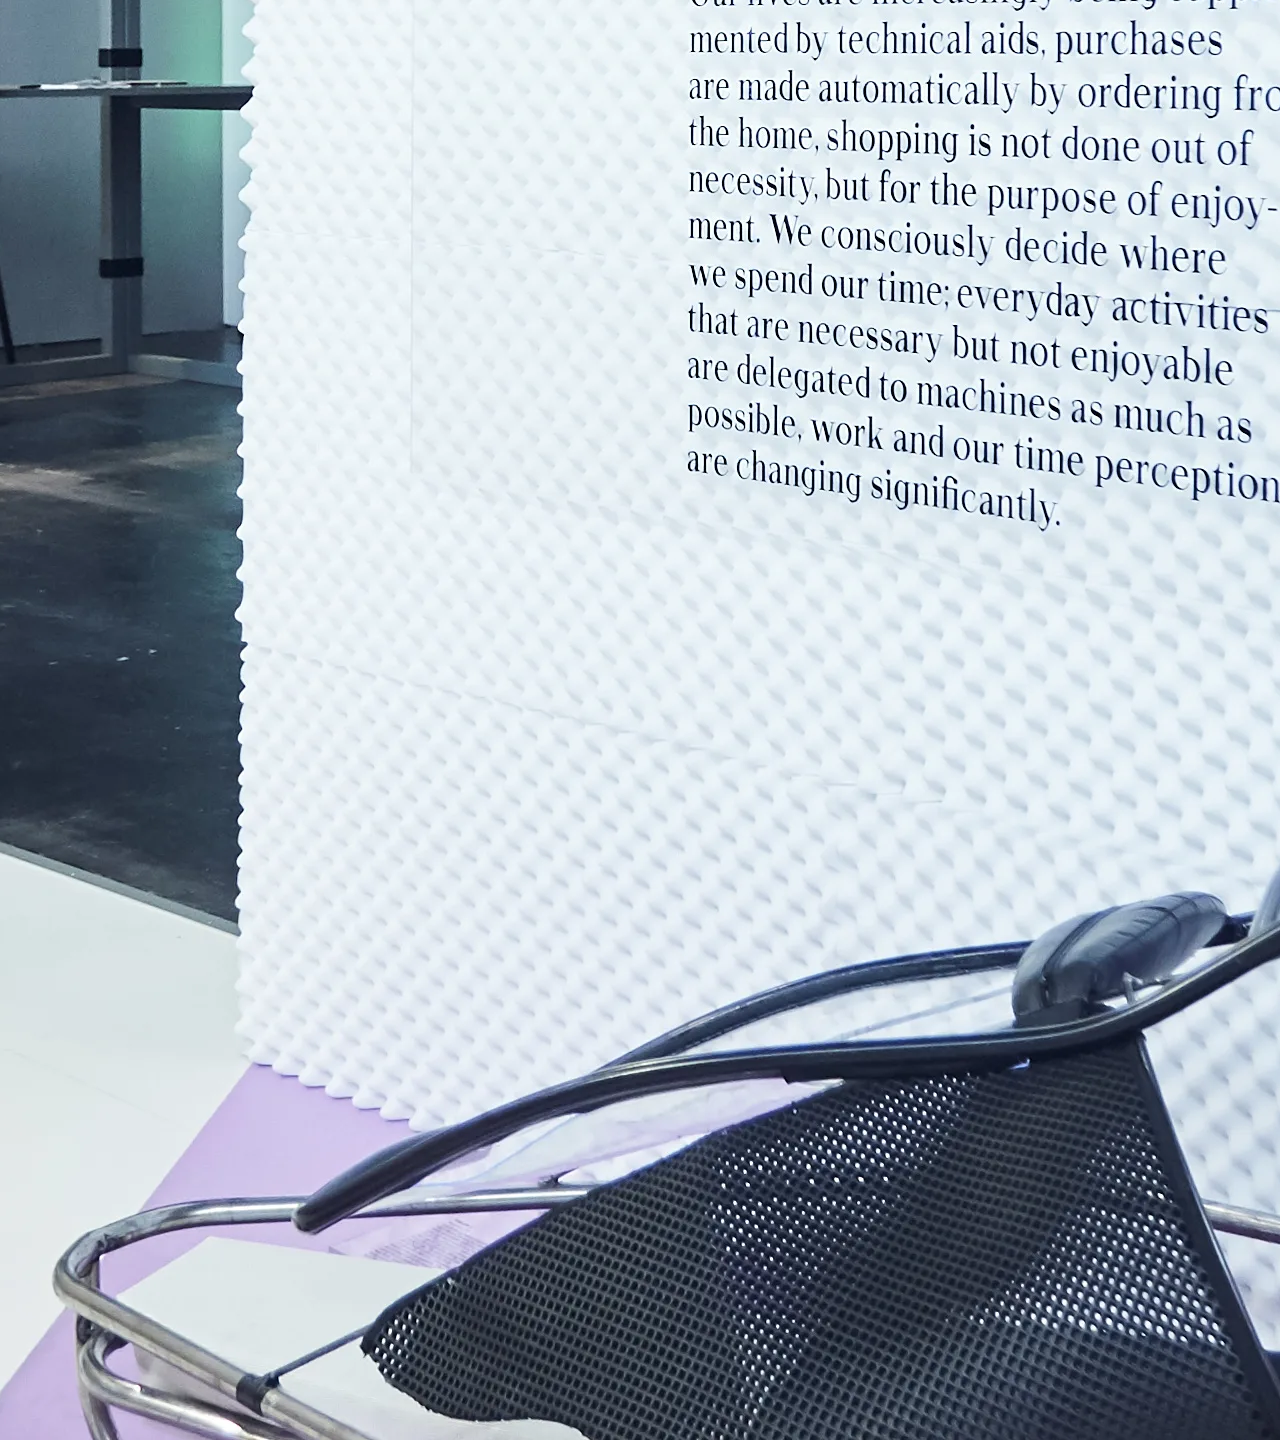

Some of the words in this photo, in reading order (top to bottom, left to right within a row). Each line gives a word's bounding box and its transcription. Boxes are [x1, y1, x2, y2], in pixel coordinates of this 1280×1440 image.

[689, 21, 789, 54] mented
[795, 21, 829, 62] by
[836, 20, 972, 55] technical
[980, 20, 1046, 58] aids,
[1055, 19, 1223, 64] purchases
[688, 78, 730, 101] are
[738, 69, 811, 103] made
[818, 71, 1021, 115] automatically
[1029, 71, 1068, 116] by
[1077, 72, 1223, 120] ordering
[688, 115, 730, 148] the
[737, 116, 819, 155] home,
[826, 118, 960, 164] shopping
[968, 123, 992, 157] is
[1001, 128, 1052, 159] not
[1061, 125, 1141, 163] done
[1150, 132, 1208, 165] out
[1216, 128, 1255, 167] of
[688, 166, 819, 206] necessity,
[825, 166, 871, 202] but
[878, 168, 921, 204] for
[929, 171, 978, 208] the
[986, 184, 1118, 220] purpose
[1127, 180, 1164, 217] of
[1171, 184, 1278, 231] enjoy-
[688, 215, 761, 244] ment.
[768, 213, 813, 247] We
[820, 221, 996, 267] consciously
[1005, 226, 1109, 267] decide
[1118, 234, 1227, 276] where
[688, 263, 728, 289] we
[734, 262, 813, 299] spend
[821, 274, 870, 300] our
[876, 270, 950, 311] time;
[956, 281, 1102, 328] everyday
[1111, 290, 1270, 336] activities
[687, 301, 740, 337] that
[746, 315, 790, 342] are
[797, 321, 944, 364] necessary
[951, 324, 1001, 363] but
[1009, 337, 1062, 369] not
[1070, 340, 1235, 387] enjoyable
[687, 357, 729, 383] are
[736, 353, 871, 399] delegated
[878, 371, 908, 403] to
[916, 378, 1062, 421] machines
[1070, 399, 1104, 427] as
[1113, 399, 1207, 439] much
[1213, 415, 1253, 444] as
[687, 401, 802, 444] possible,
[809, 415, 885, 451] work
[893, 424, 944, 459] and
[952, 437, 1005, 466] our
[1013, 436, 1086, 477] time
[687, 450, 730, 477] are
[736, 448, 862, 504] changing
[870, 468, 1061, 533] significantly.
